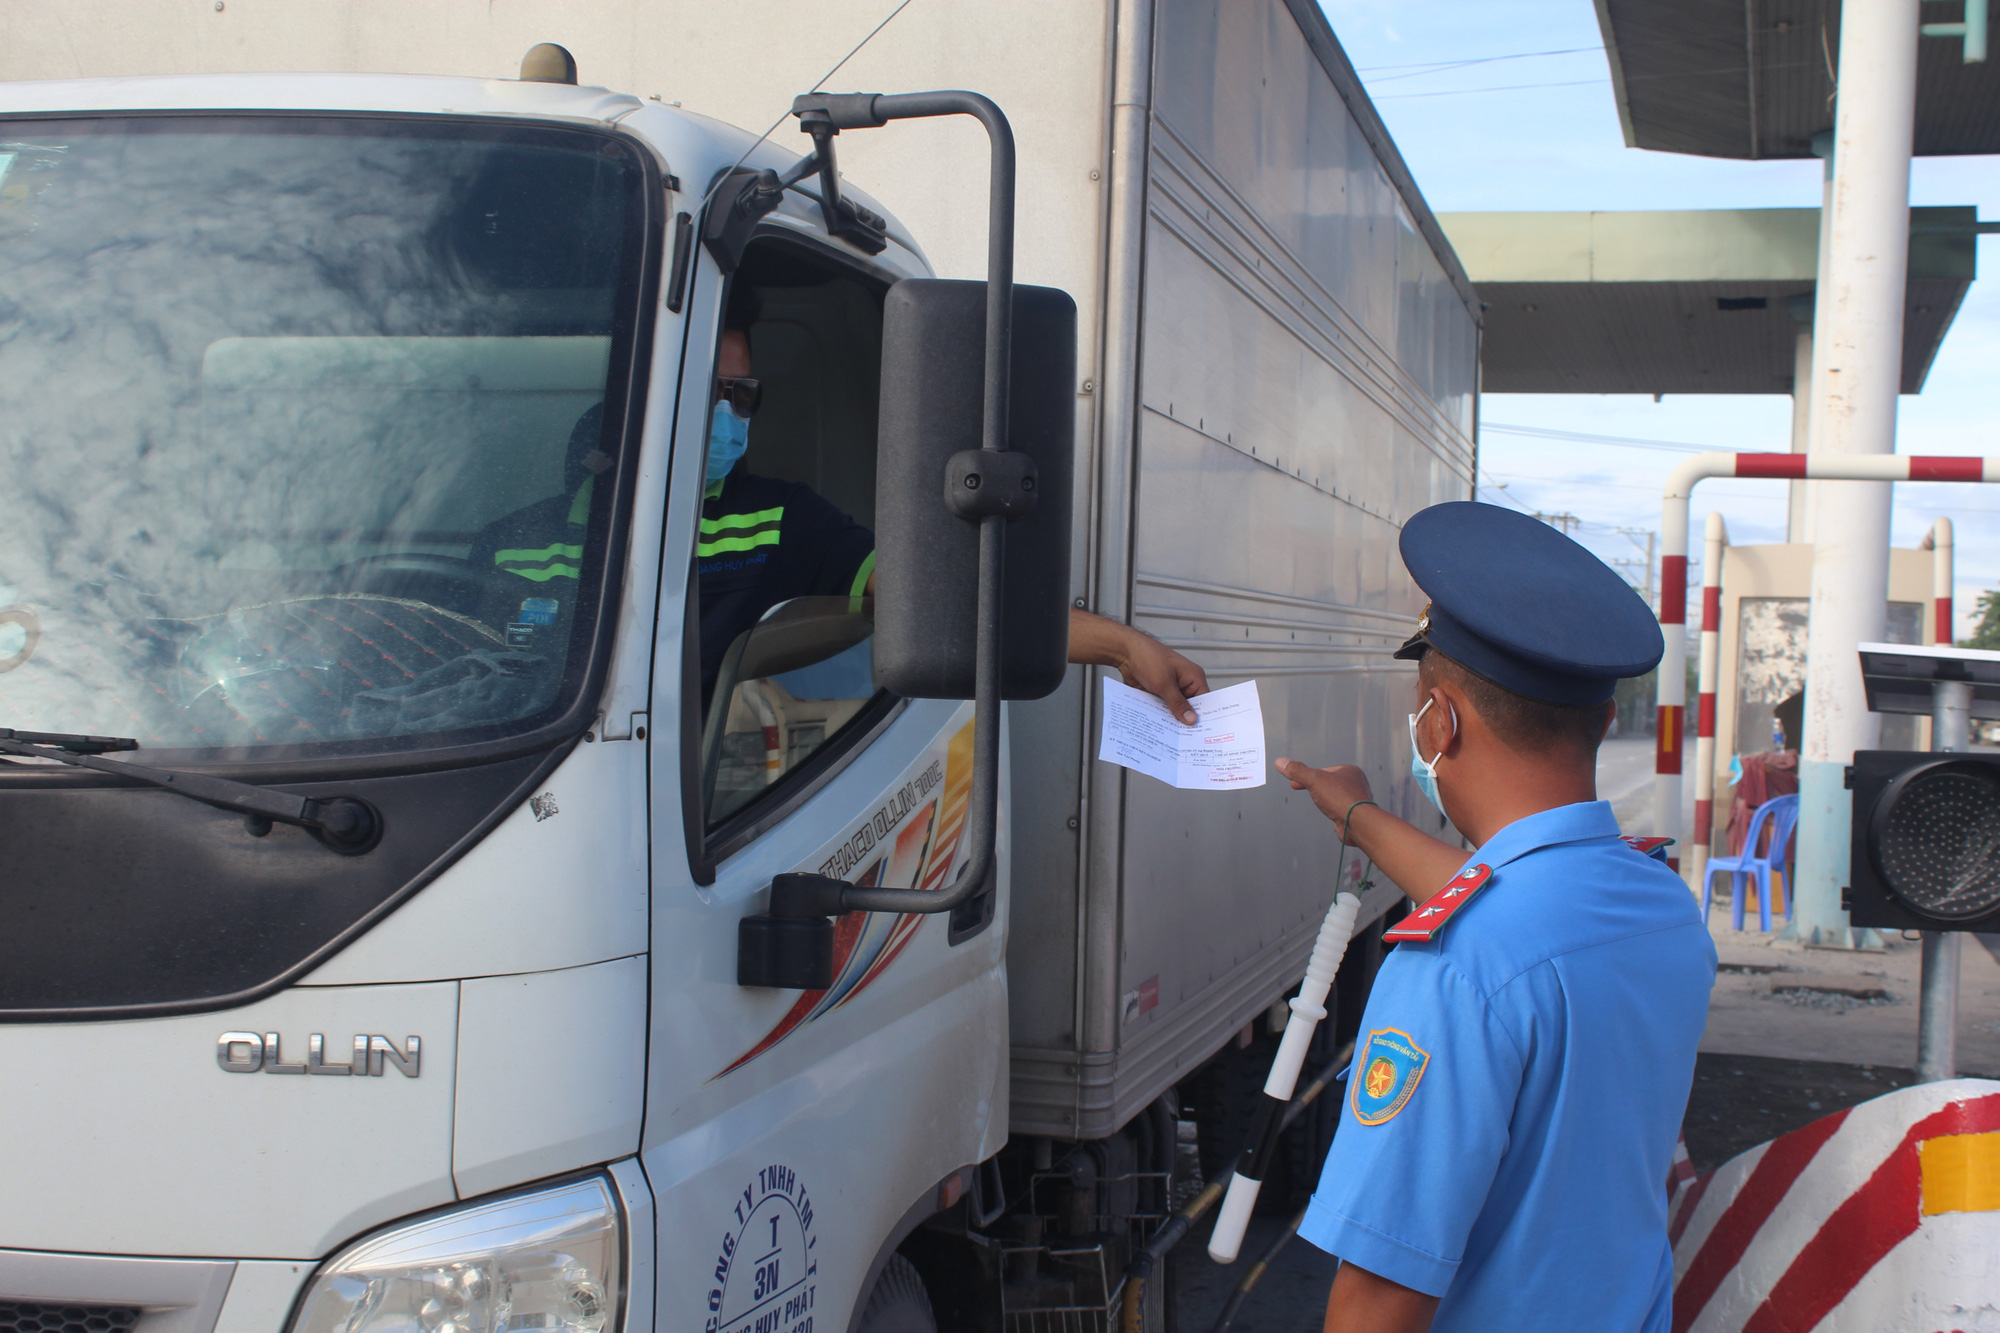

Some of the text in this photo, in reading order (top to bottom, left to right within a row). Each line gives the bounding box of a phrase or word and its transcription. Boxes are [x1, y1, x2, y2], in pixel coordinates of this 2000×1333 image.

[819, 823, 875, 880] THACO
[873, 782, 917, 840] OLLIN
[217, 1031, 420, 1077] OLLIN
[705, 1231, 735, 1333] CÔNG
[734, 1183, 752, 1225] TY
[759, 1164, 796, 1196] TNHH
[797, 1183, 814, 1232] TM
[770, 1214, 780, 1248] T
[754, 1258, 780, 1301] 3N
[755, 1306, 781, 1333] HUY
[785, 1284, 816, 1324] PHÁT
